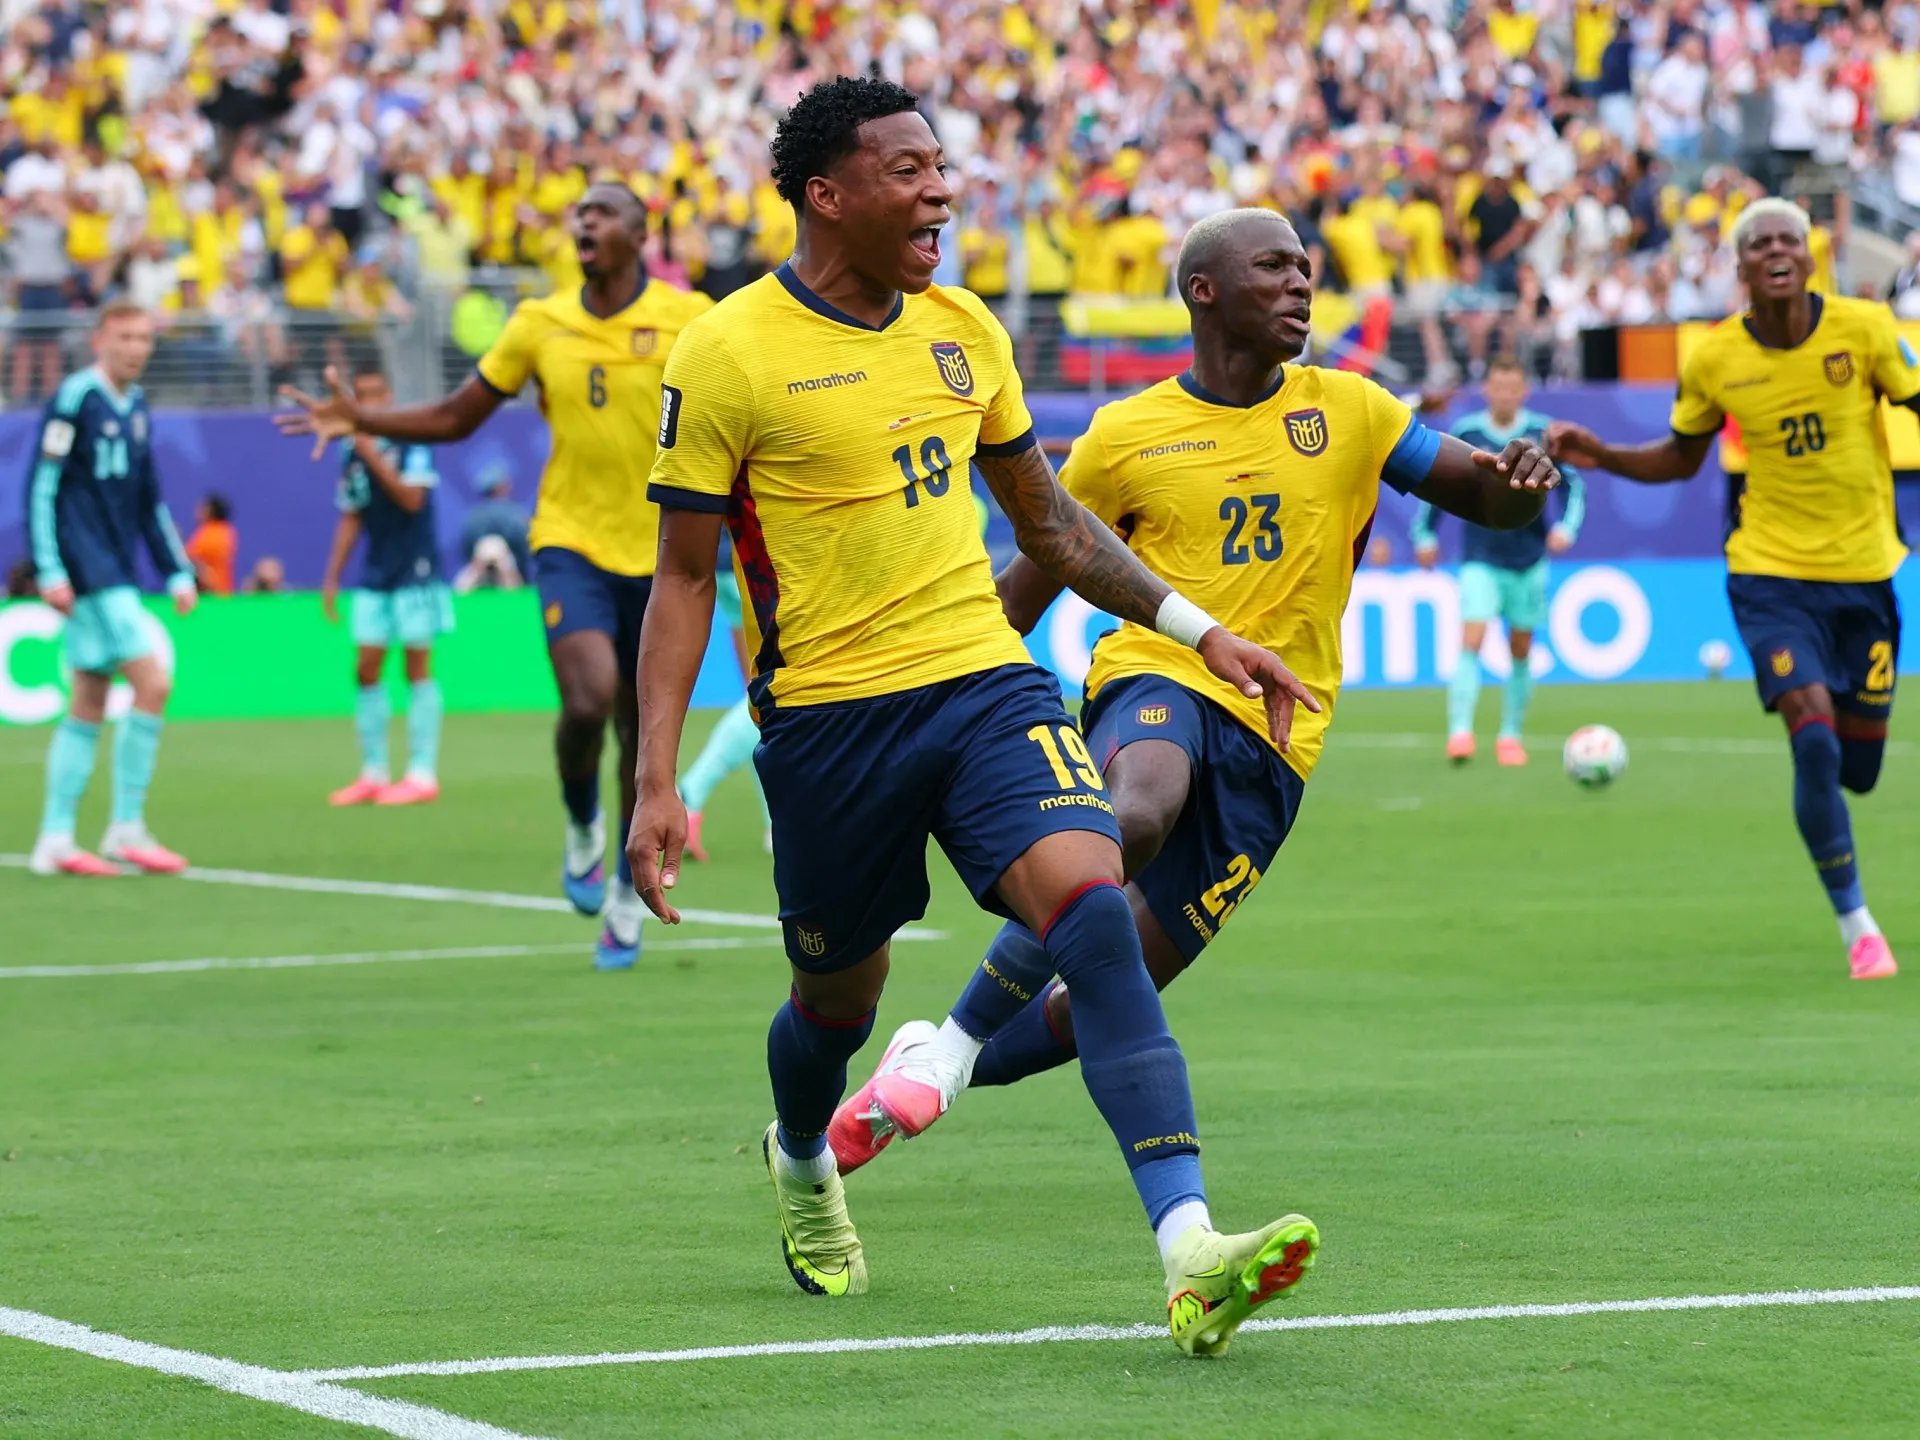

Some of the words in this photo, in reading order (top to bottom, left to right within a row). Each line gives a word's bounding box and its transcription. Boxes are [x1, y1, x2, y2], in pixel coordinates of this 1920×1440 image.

[589, 364, 607, 409] 6
[787, 370, 868, 395] marathon
[1140, 440, 1217, 460] marathon
[1780, 412, 1826, 457] 20
[1219, 493, 1283, 566] 23
[1027, 724, 1104, 791] 19
[1039, 792, 1115, 816] marathon
